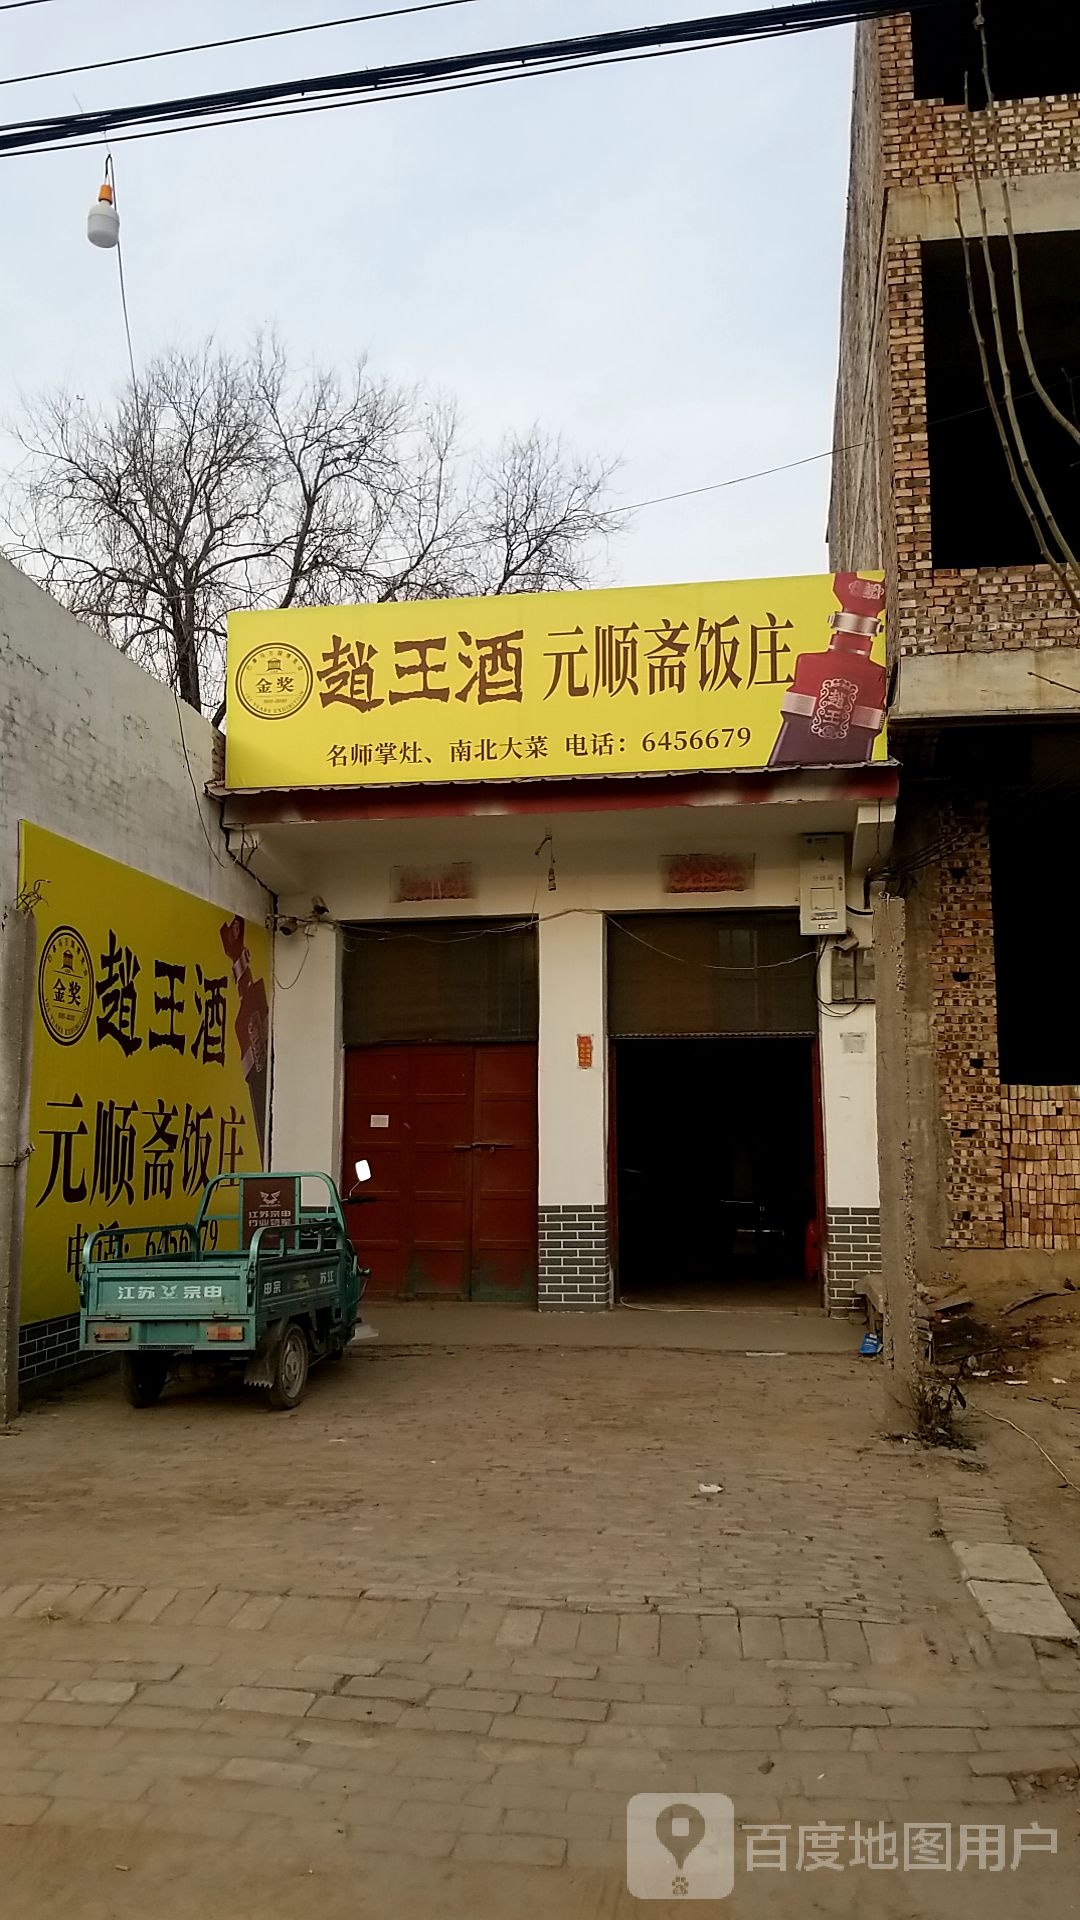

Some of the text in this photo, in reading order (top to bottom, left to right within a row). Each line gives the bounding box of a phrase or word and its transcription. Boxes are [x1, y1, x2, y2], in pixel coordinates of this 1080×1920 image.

[256, 676, 294, 694] 金奖
[541, 611, 795, 701] 元顺斋饭庄
[53, 978, 81, 1006] 金奖
[36, 1092, 247, 1208] 元顺斋饭庄
